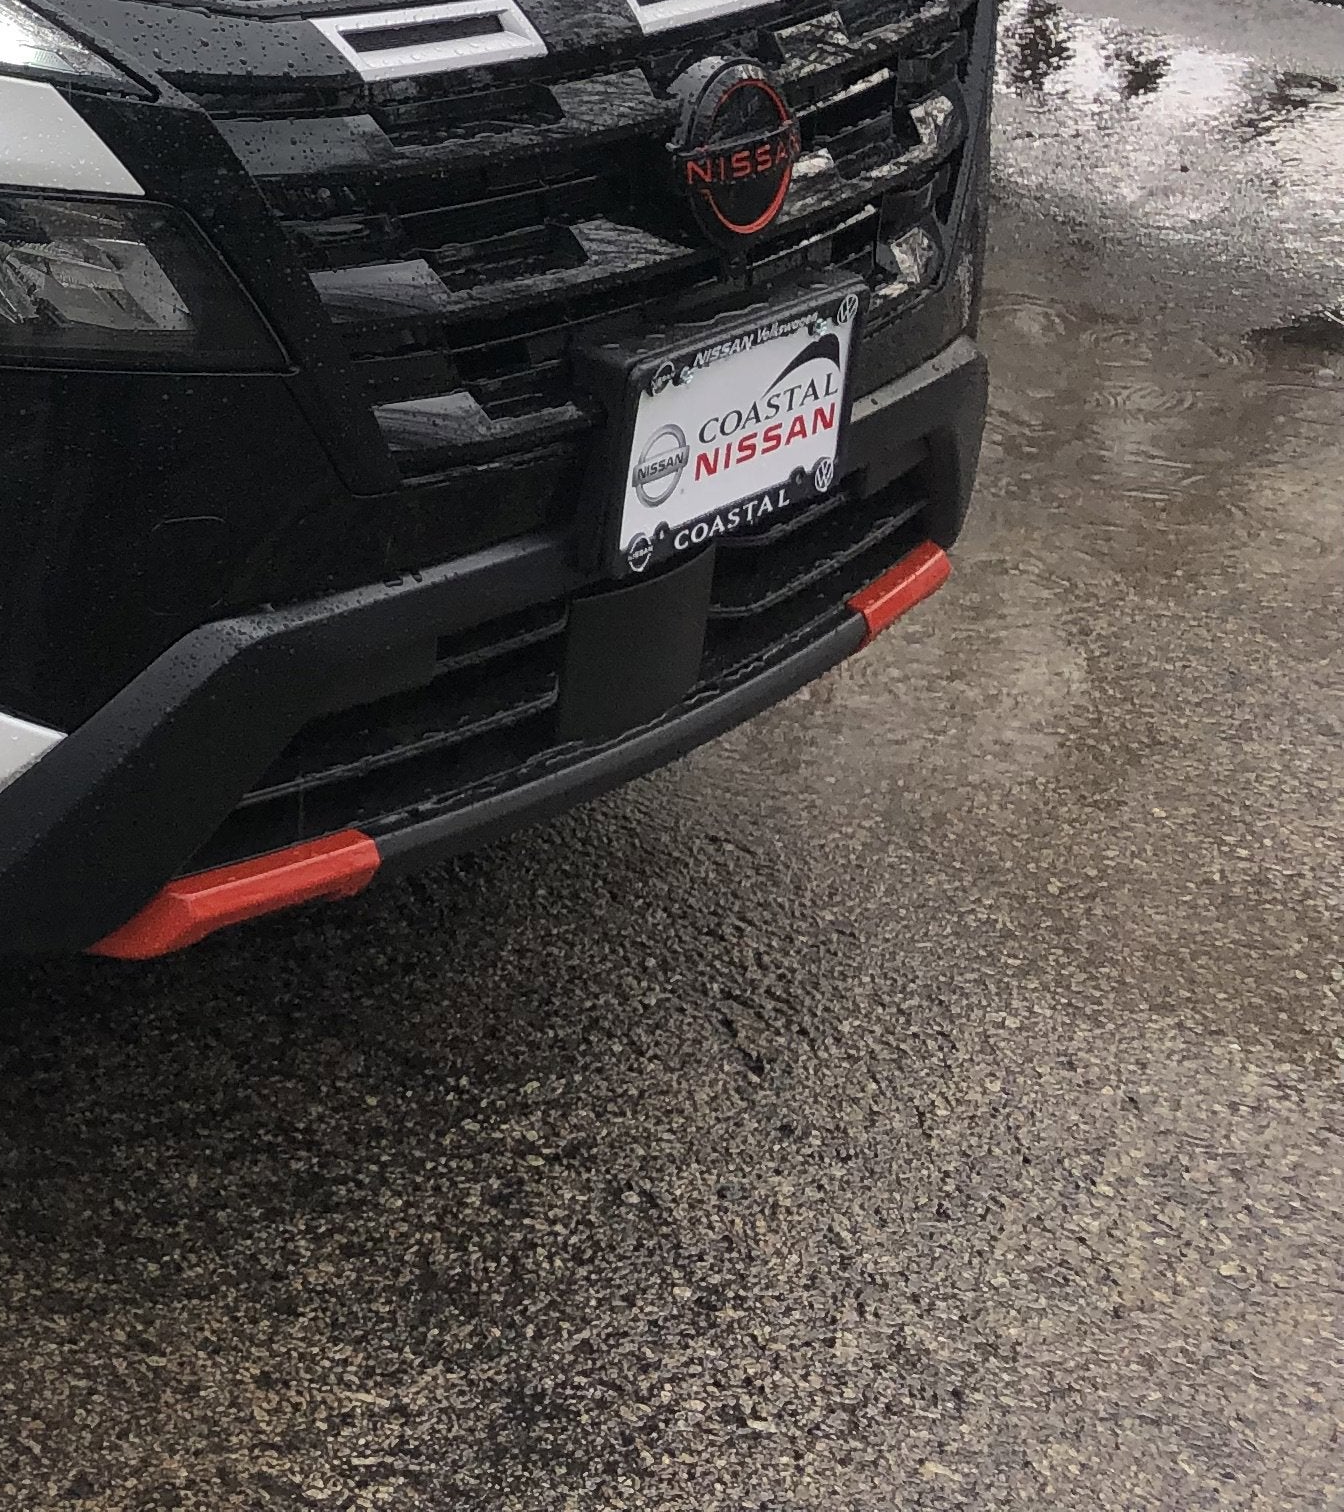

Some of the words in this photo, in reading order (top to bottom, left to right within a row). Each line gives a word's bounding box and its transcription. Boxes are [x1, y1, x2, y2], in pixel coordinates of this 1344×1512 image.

[686, 133, 800, 185] NISSAN
[693, 333, 755, 368] NISSAN
[698, 372, 839, 444] COASTAL
[637, 451, 684, 480] NISSAN
[694, 402, 836, 482] NISSAN
[673, 489, 790, 550] COASTAL
